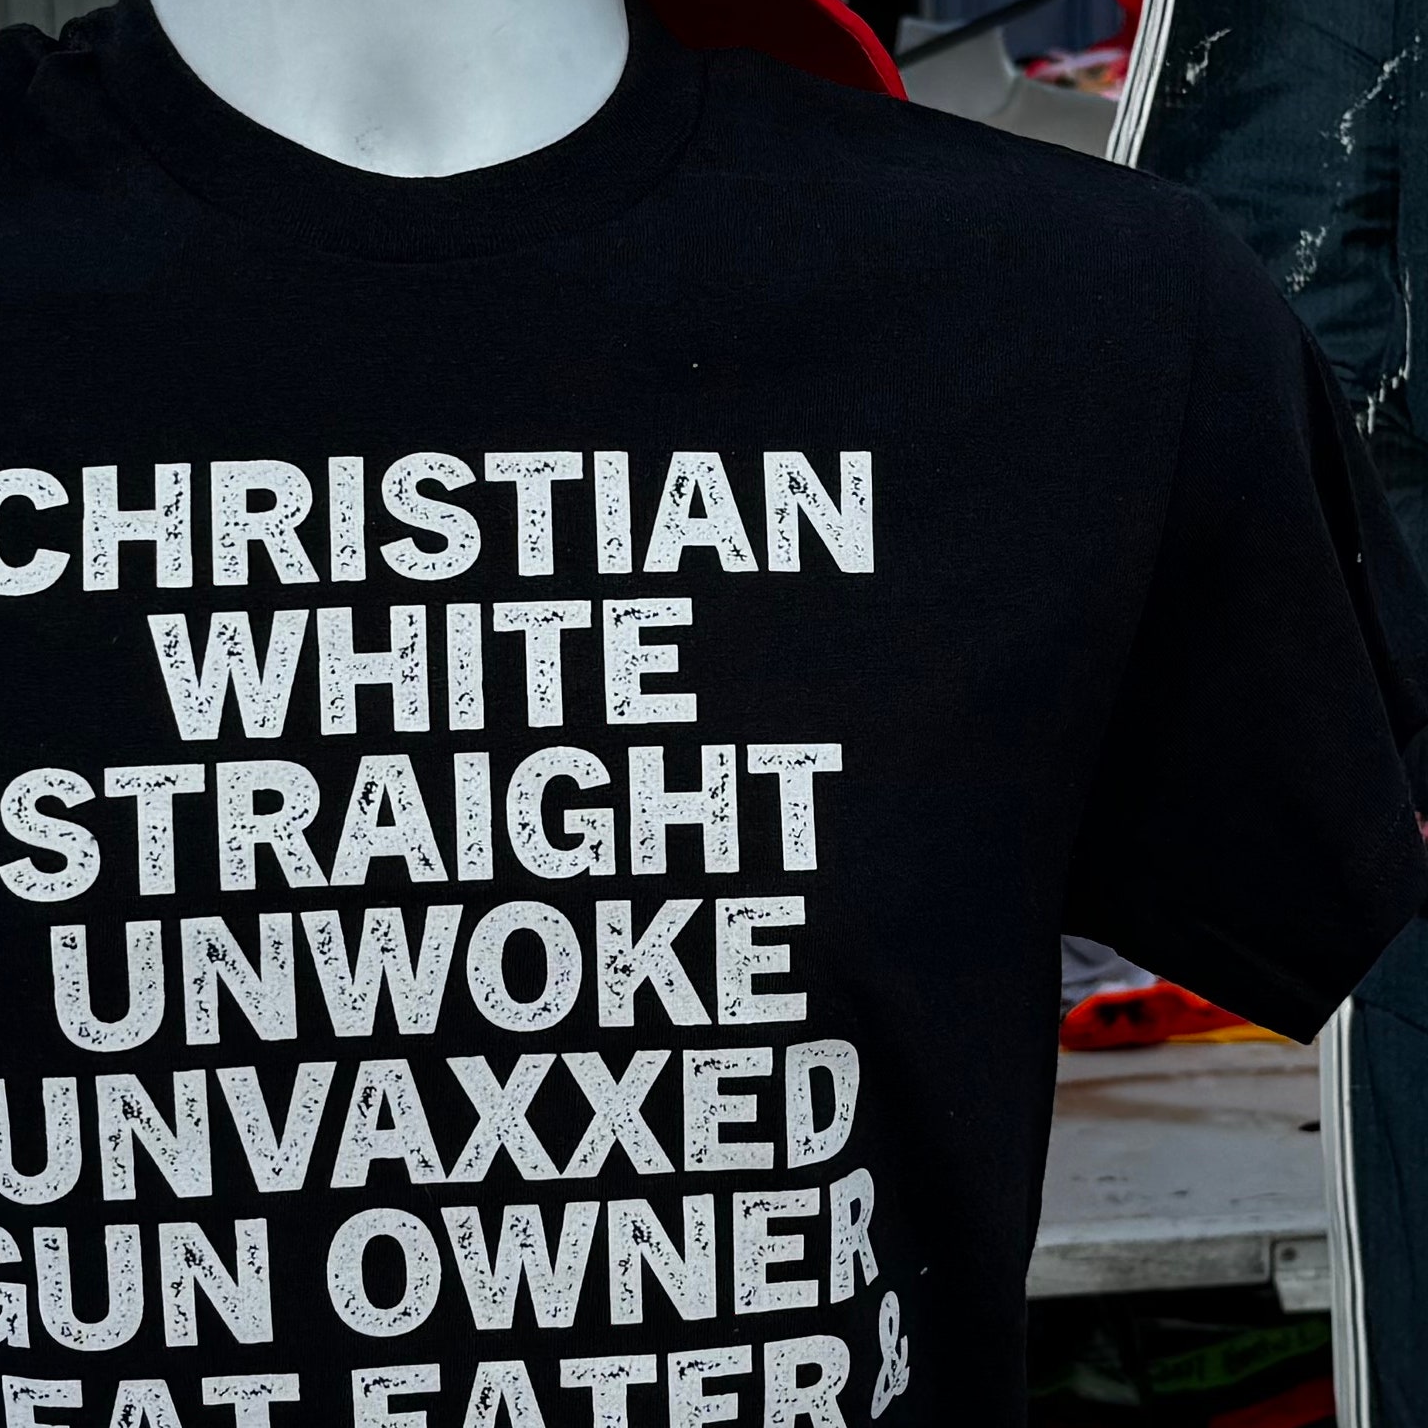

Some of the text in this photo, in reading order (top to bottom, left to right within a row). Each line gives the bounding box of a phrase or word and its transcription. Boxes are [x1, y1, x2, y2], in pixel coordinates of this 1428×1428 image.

[147, 597, 698, 740] WHITE
[50, 896, 808, 1052] UNWOKE
[327, 1168, 880, 1335] OWNER
[870, 1291, 911, 1420] &
